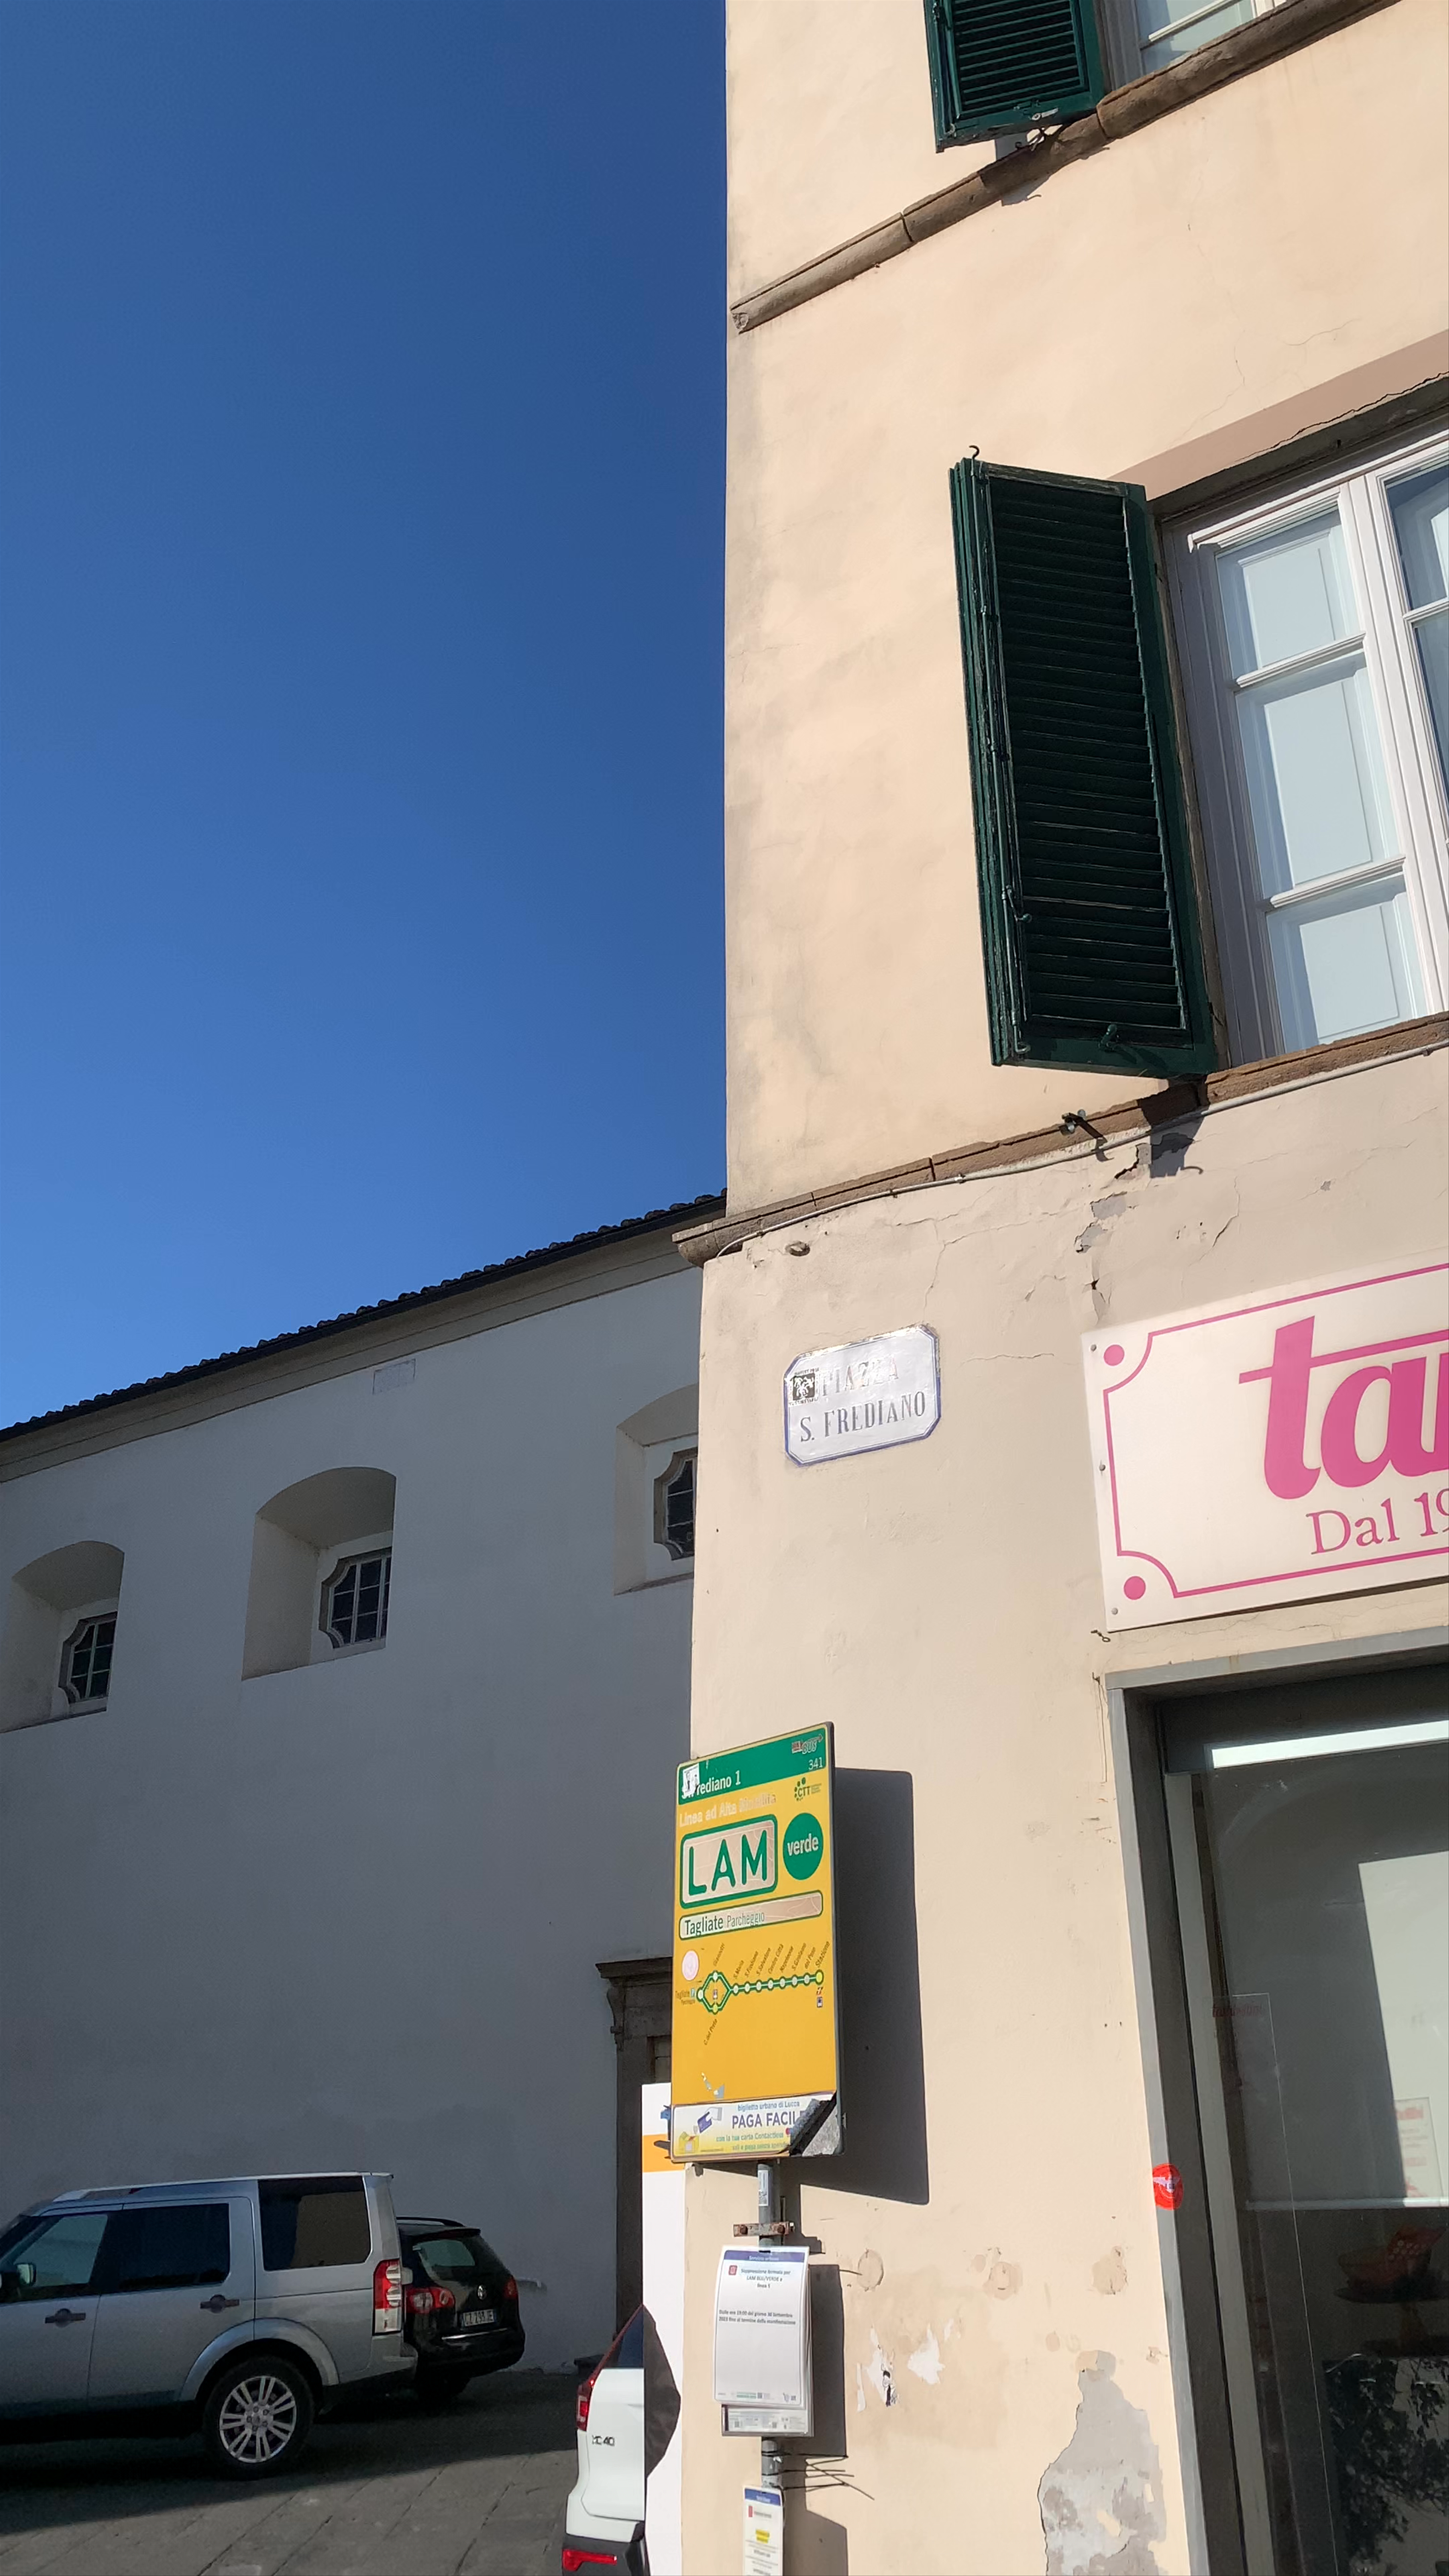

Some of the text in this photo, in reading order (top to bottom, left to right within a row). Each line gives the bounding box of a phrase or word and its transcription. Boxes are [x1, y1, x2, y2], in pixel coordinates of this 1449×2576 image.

[800, 1391, 925, 1442] S. FREDIANO
[1306, 1498, 1400, 1555] Dal
[808, 1757, 823, 1770] 341
[735, 1770, 741, 1785] 1
[798, 1786, 811, 1797] CTT
[680, 1812, 703, 1827] Linea
[705, 1805, 717, 1821] ad
[718, 1802, 737, 1817] Alta
[787, 1833, 819, 1856] verde
[689, 1830, 767, 1896] LAM
[685, 1912, 765, 1936] Tagliate Parcheggio
[738, 2104, 758, 2112] biglietto
[732, 2113, 762, 2129] PAGA
